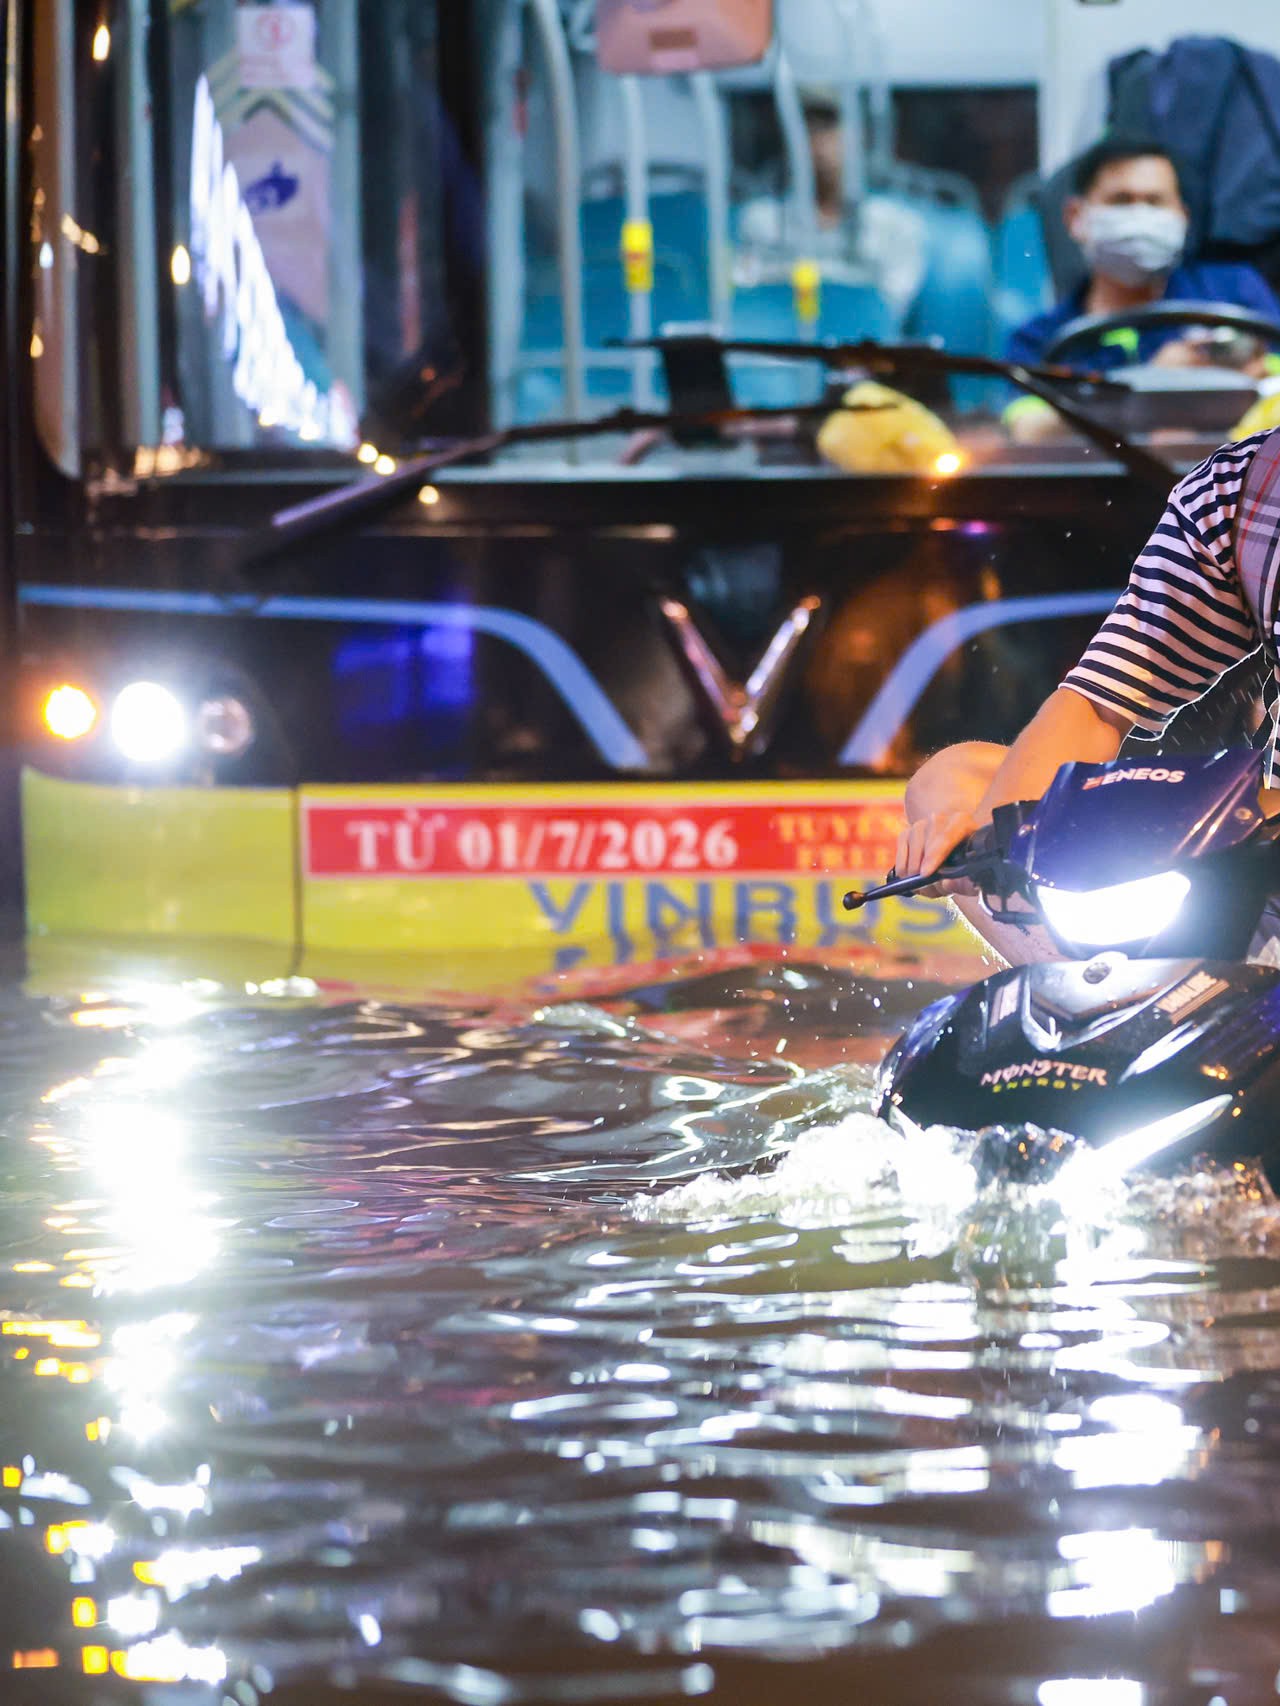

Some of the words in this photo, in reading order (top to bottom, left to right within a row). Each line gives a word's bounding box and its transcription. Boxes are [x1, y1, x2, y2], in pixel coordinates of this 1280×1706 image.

[1100, 767, 1186, 786] ENEOS
[345, 807, 448, 871] TỪ
[456, 817, 739, 871] 01/7/2026
[978, 1057, 1108, 1087] MONSTER
